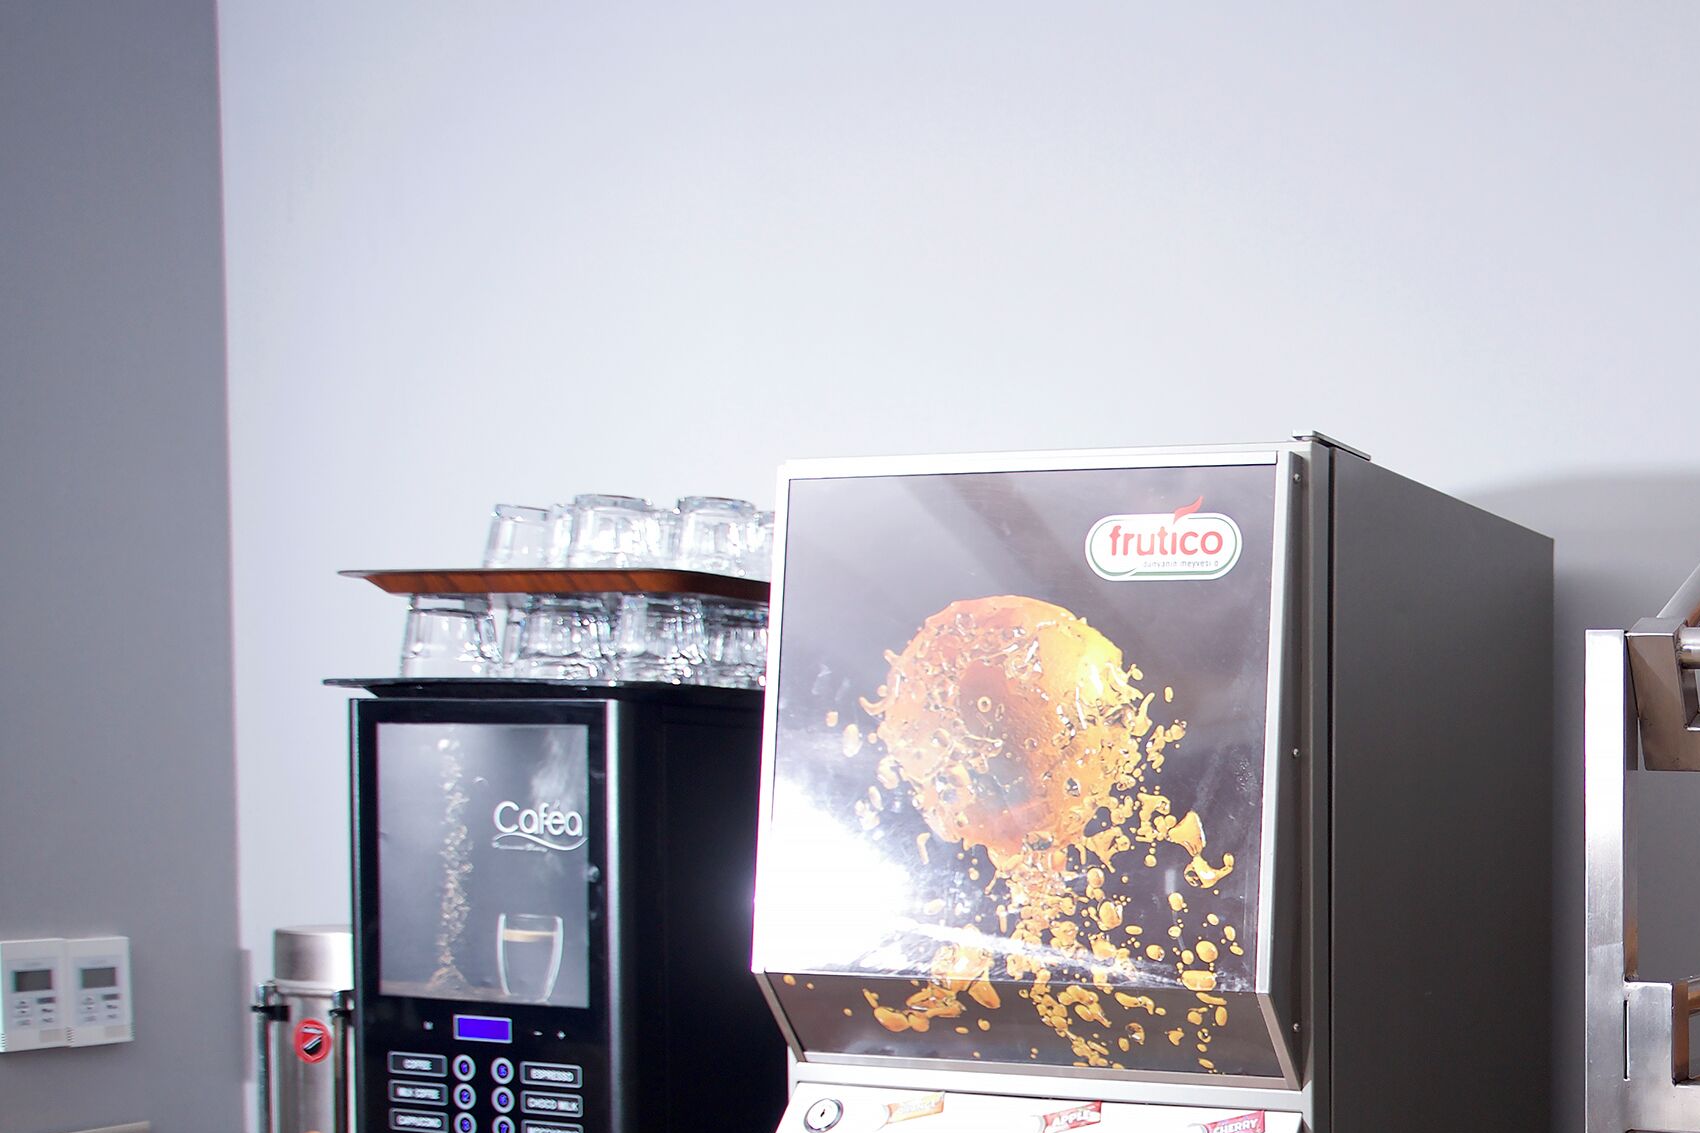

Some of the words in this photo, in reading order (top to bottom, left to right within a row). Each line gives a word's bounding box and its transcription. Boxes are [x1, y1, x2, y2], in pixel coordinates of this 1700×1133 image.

[1109, 525, 1223, 556] frutico
[493, 800, 583, 837] Caféa
[530, 1068, 574, 1082] ESPRESSO
